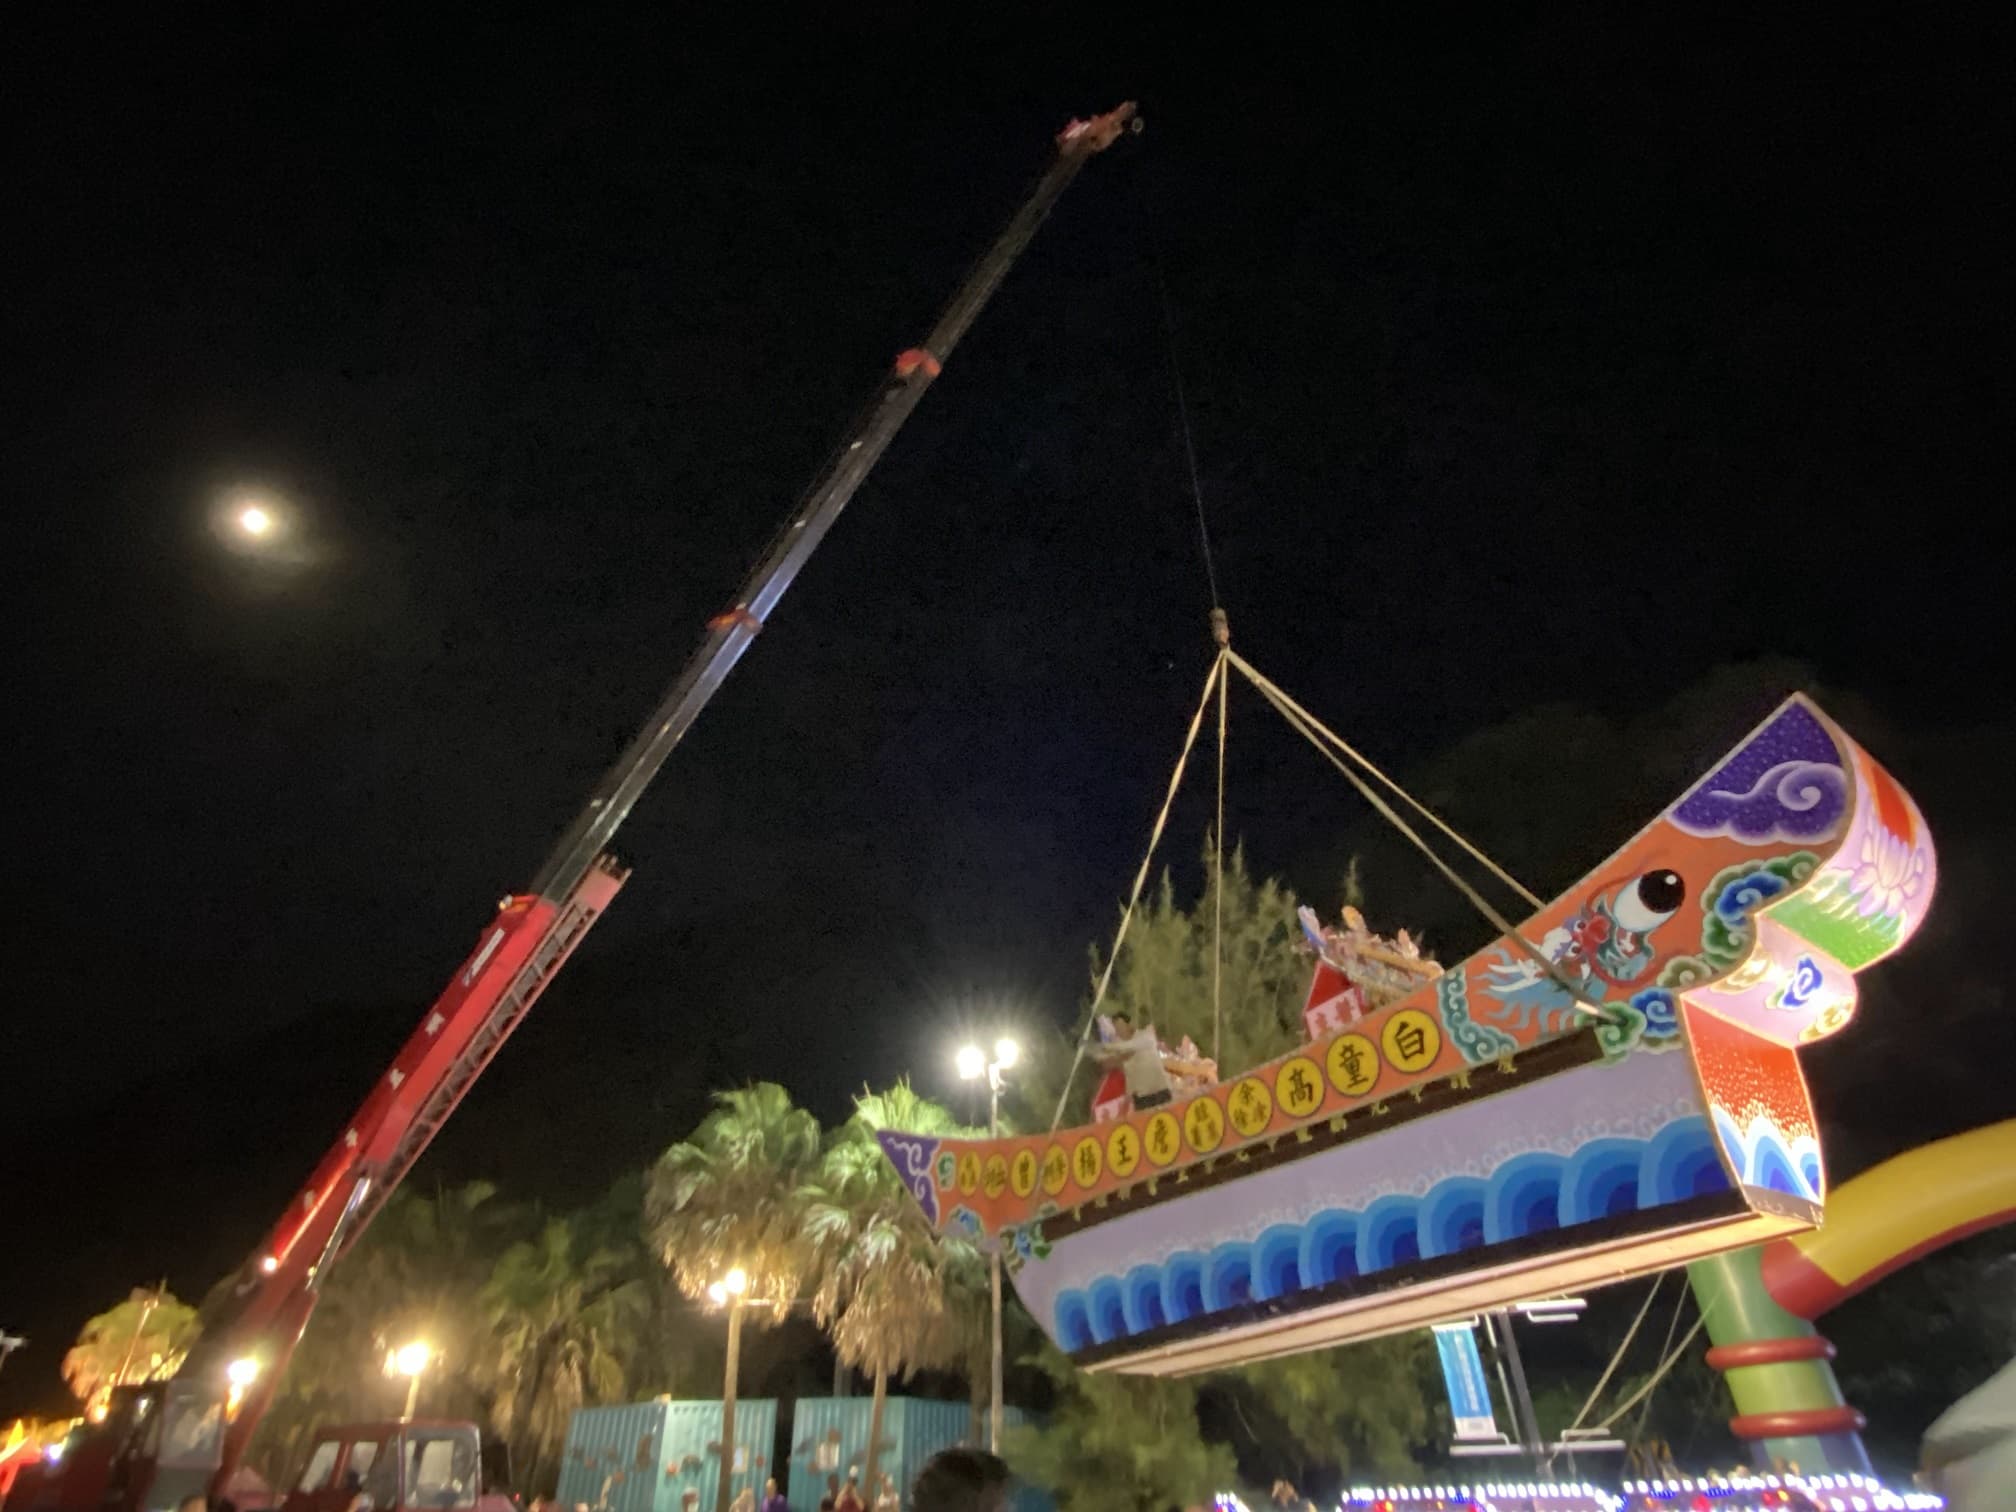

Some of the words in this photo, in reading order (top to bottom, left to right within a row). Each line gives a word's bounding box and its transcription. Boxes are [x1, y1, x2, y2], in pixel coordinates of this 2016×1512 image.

[1395, 1021, 1425, 1061] 白
[1339, 1043, 1369, 1089] 童
[1290, 1067, 1314, 1107] 高
